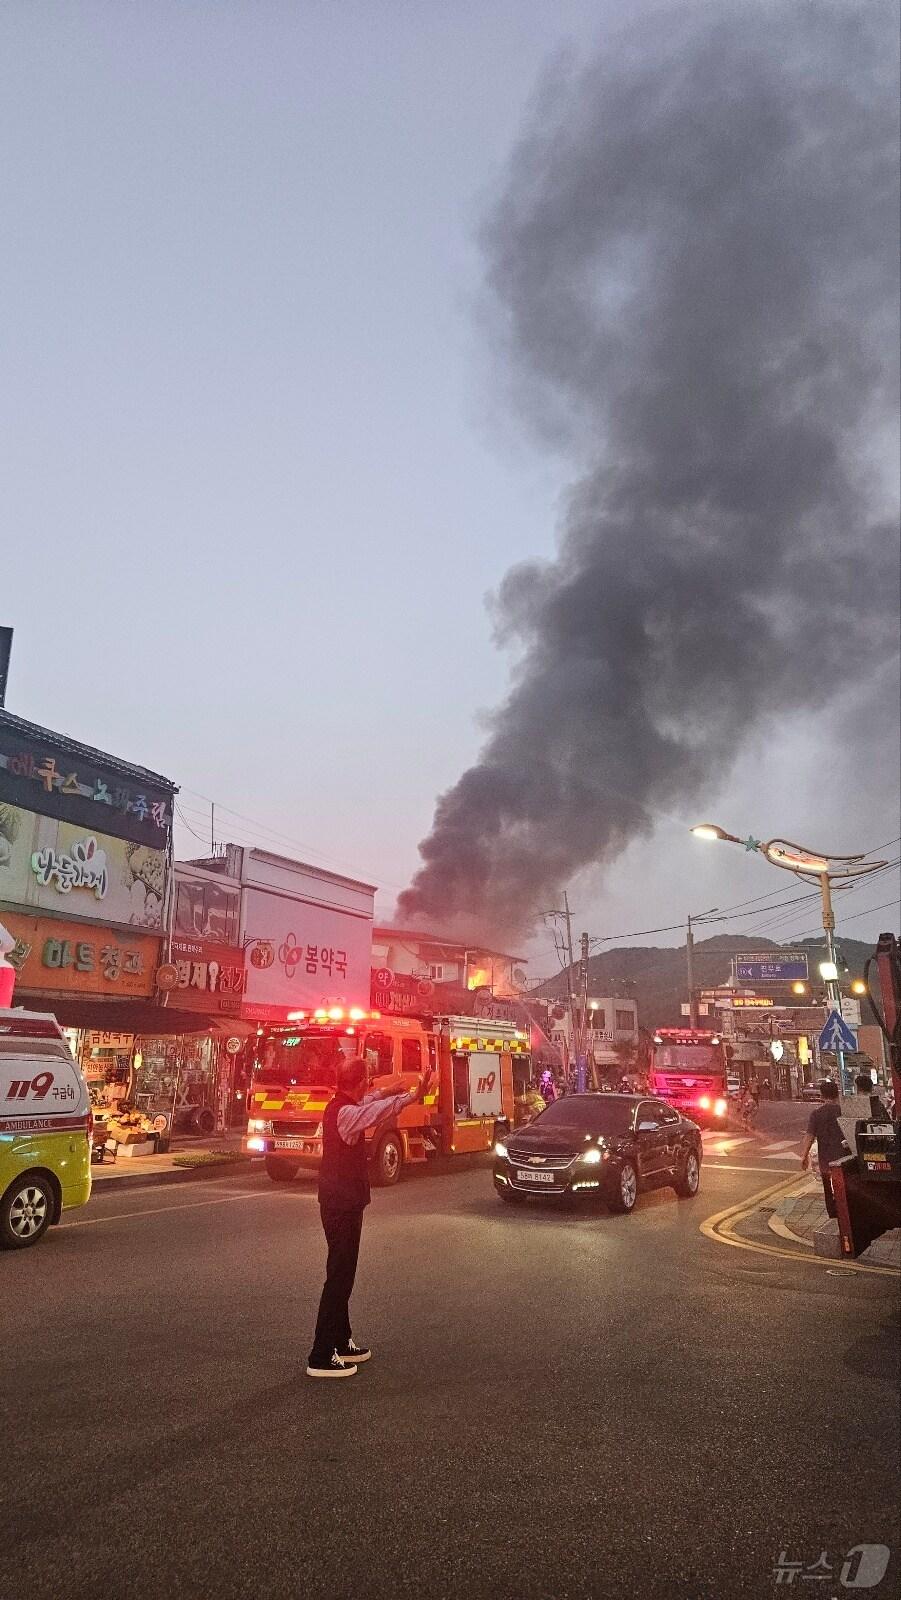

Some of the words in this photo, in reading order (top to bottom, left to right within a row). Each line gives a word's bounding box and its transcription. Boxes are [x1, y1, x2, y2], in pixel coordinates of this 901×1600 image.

[100, 945, 145, 981] 청과
[305, 943, 348, 979] 봄약국
[176, 960, 208, 990] 형제
[219, 965, 248, 994] 전기
[378, 972, 389, 986] 약
[5, 1071, 55, 1101] 119
[52, 1084, 75, 1100] 구급대
[476, 1071, 496, 1094] 119
[5, 1119, 53, 1130] AMBULANCE
[534, 1173, 551, 1182] 8142
